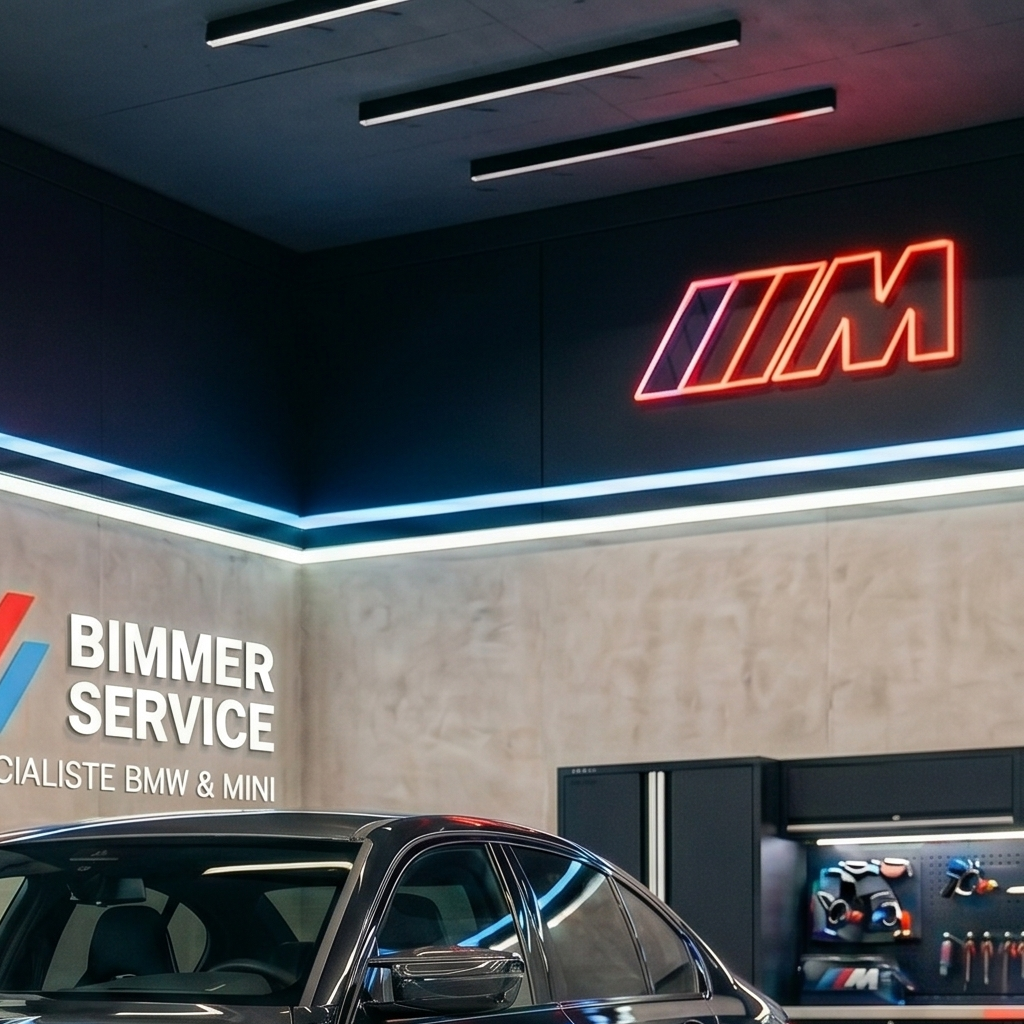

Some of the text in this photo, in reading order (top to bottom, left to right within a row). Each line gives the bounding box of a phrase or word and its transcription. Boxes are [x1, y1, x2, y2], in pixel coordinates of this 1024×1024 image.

[69, 613, 275, 693] BIMMER
[68, 681, 275, 752] SERVICE
[125, 765, 189, 797] BMW
[197, 772, 215, 798] &
[223, 774, 275, 802] MINI
